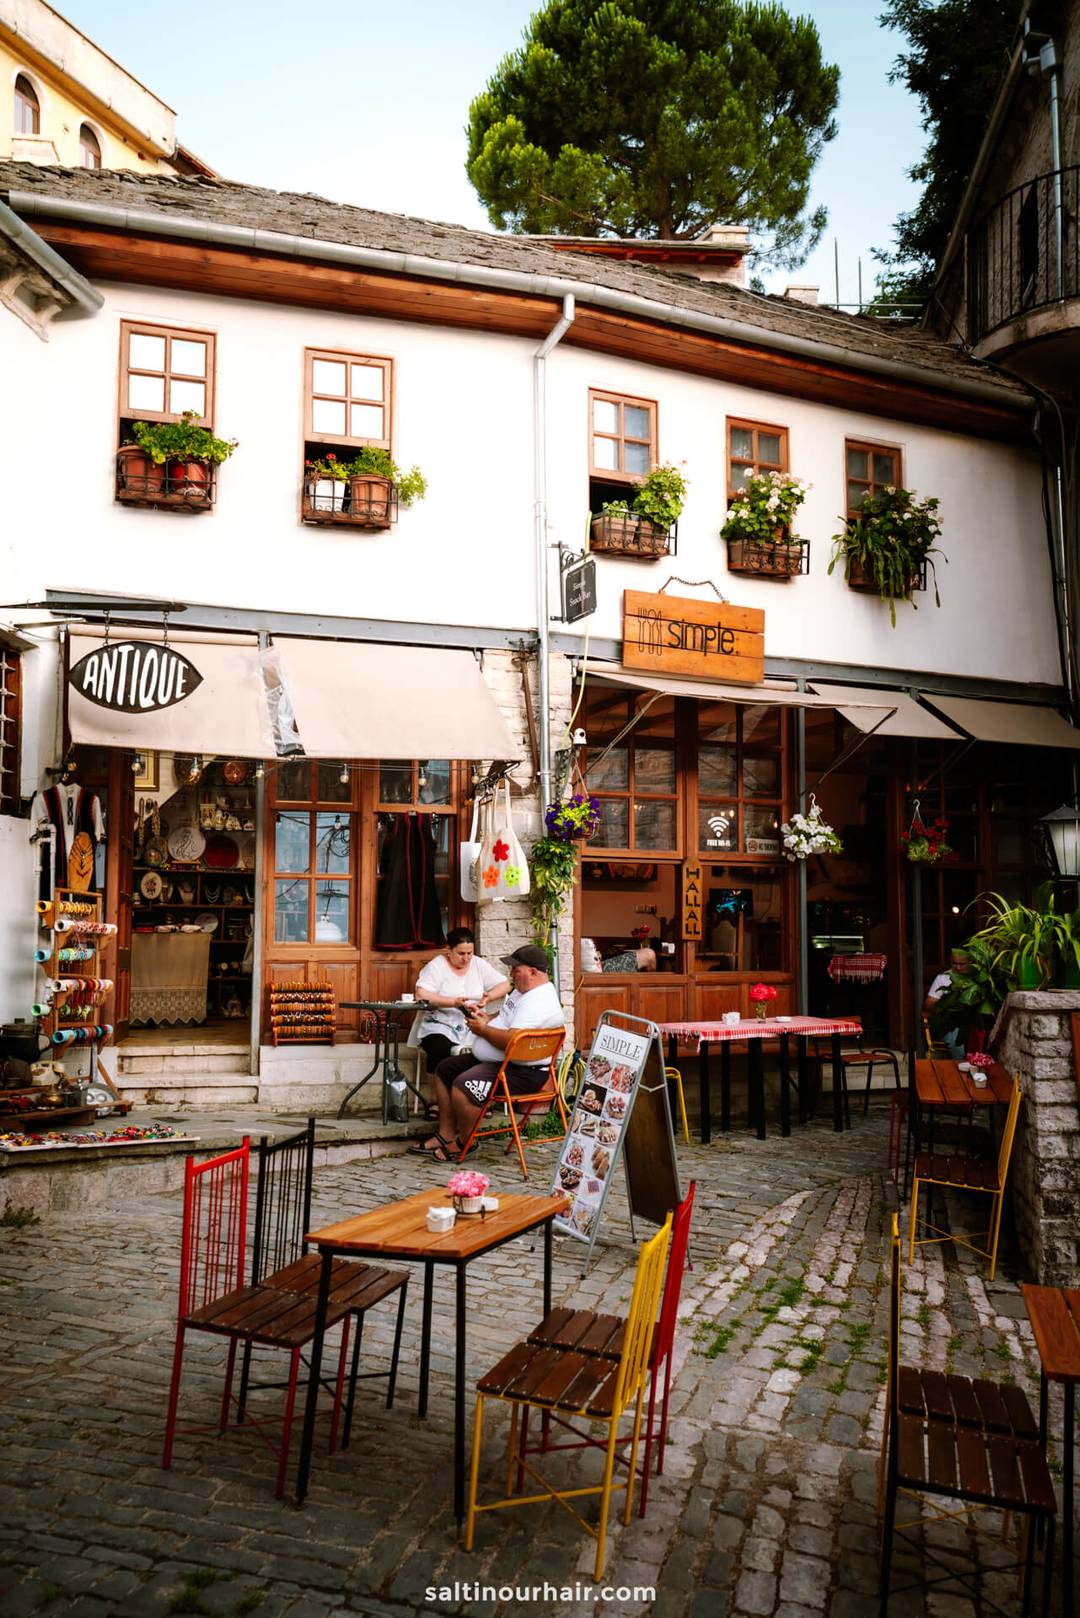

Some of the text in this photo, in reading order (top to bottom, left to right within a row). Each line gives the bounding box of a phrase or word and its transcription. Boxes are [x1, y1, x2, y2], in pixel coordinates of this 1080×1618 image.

[82, 644, 190, 709] ANTIQUE
[685, 867, 701, 935] HALLALL
[600, 1034, 643, 1059] SIMPLE
